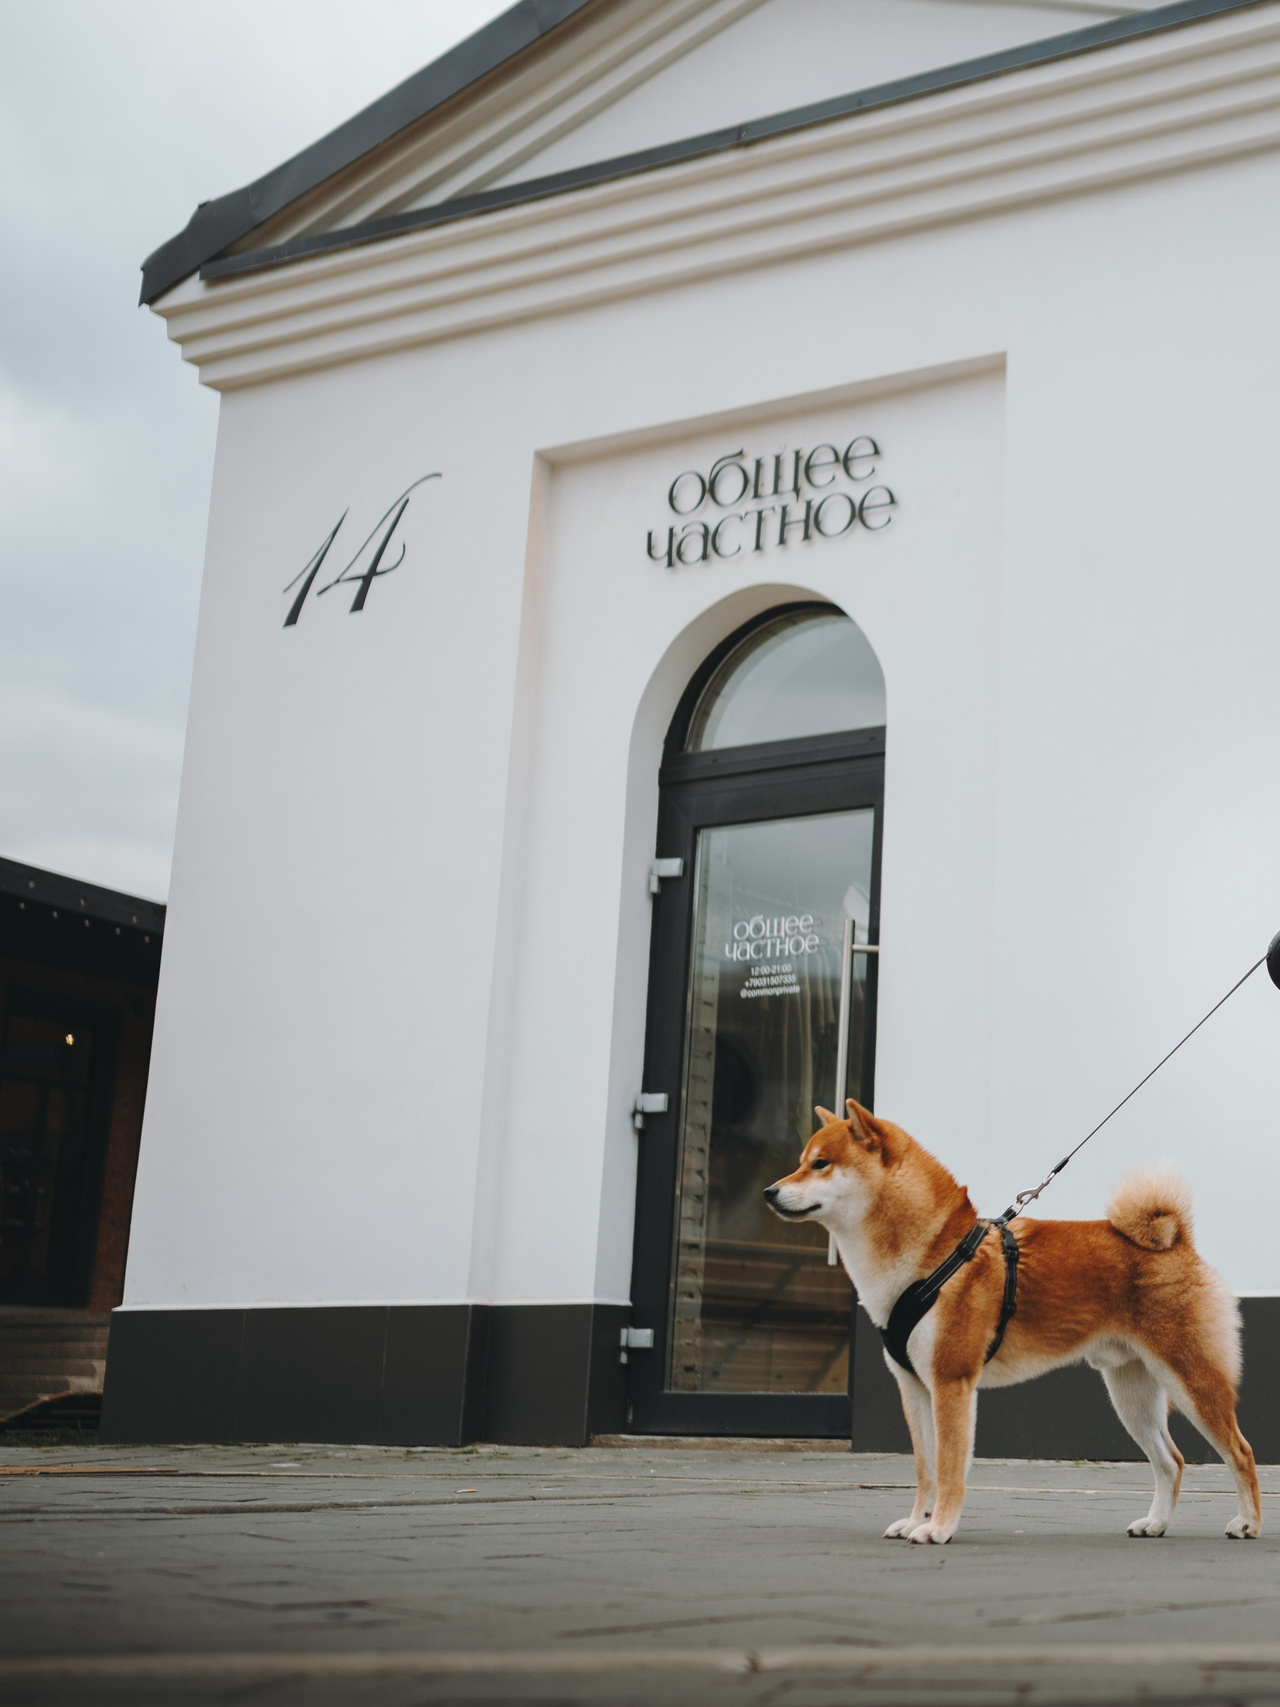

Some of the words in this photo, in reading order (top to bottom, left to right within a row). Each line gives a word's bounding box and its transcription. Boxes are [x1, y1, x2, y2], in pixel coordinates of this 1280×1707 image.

[667, 435, 881, 516] общее
[282, 472, 443, 628] 14
[645, 484, 897, 569] частное
[725, 934, 819, 961] частное
[734, 914, 813, 941] общее
[751, 963, 791, 976] 12:00-21:00
